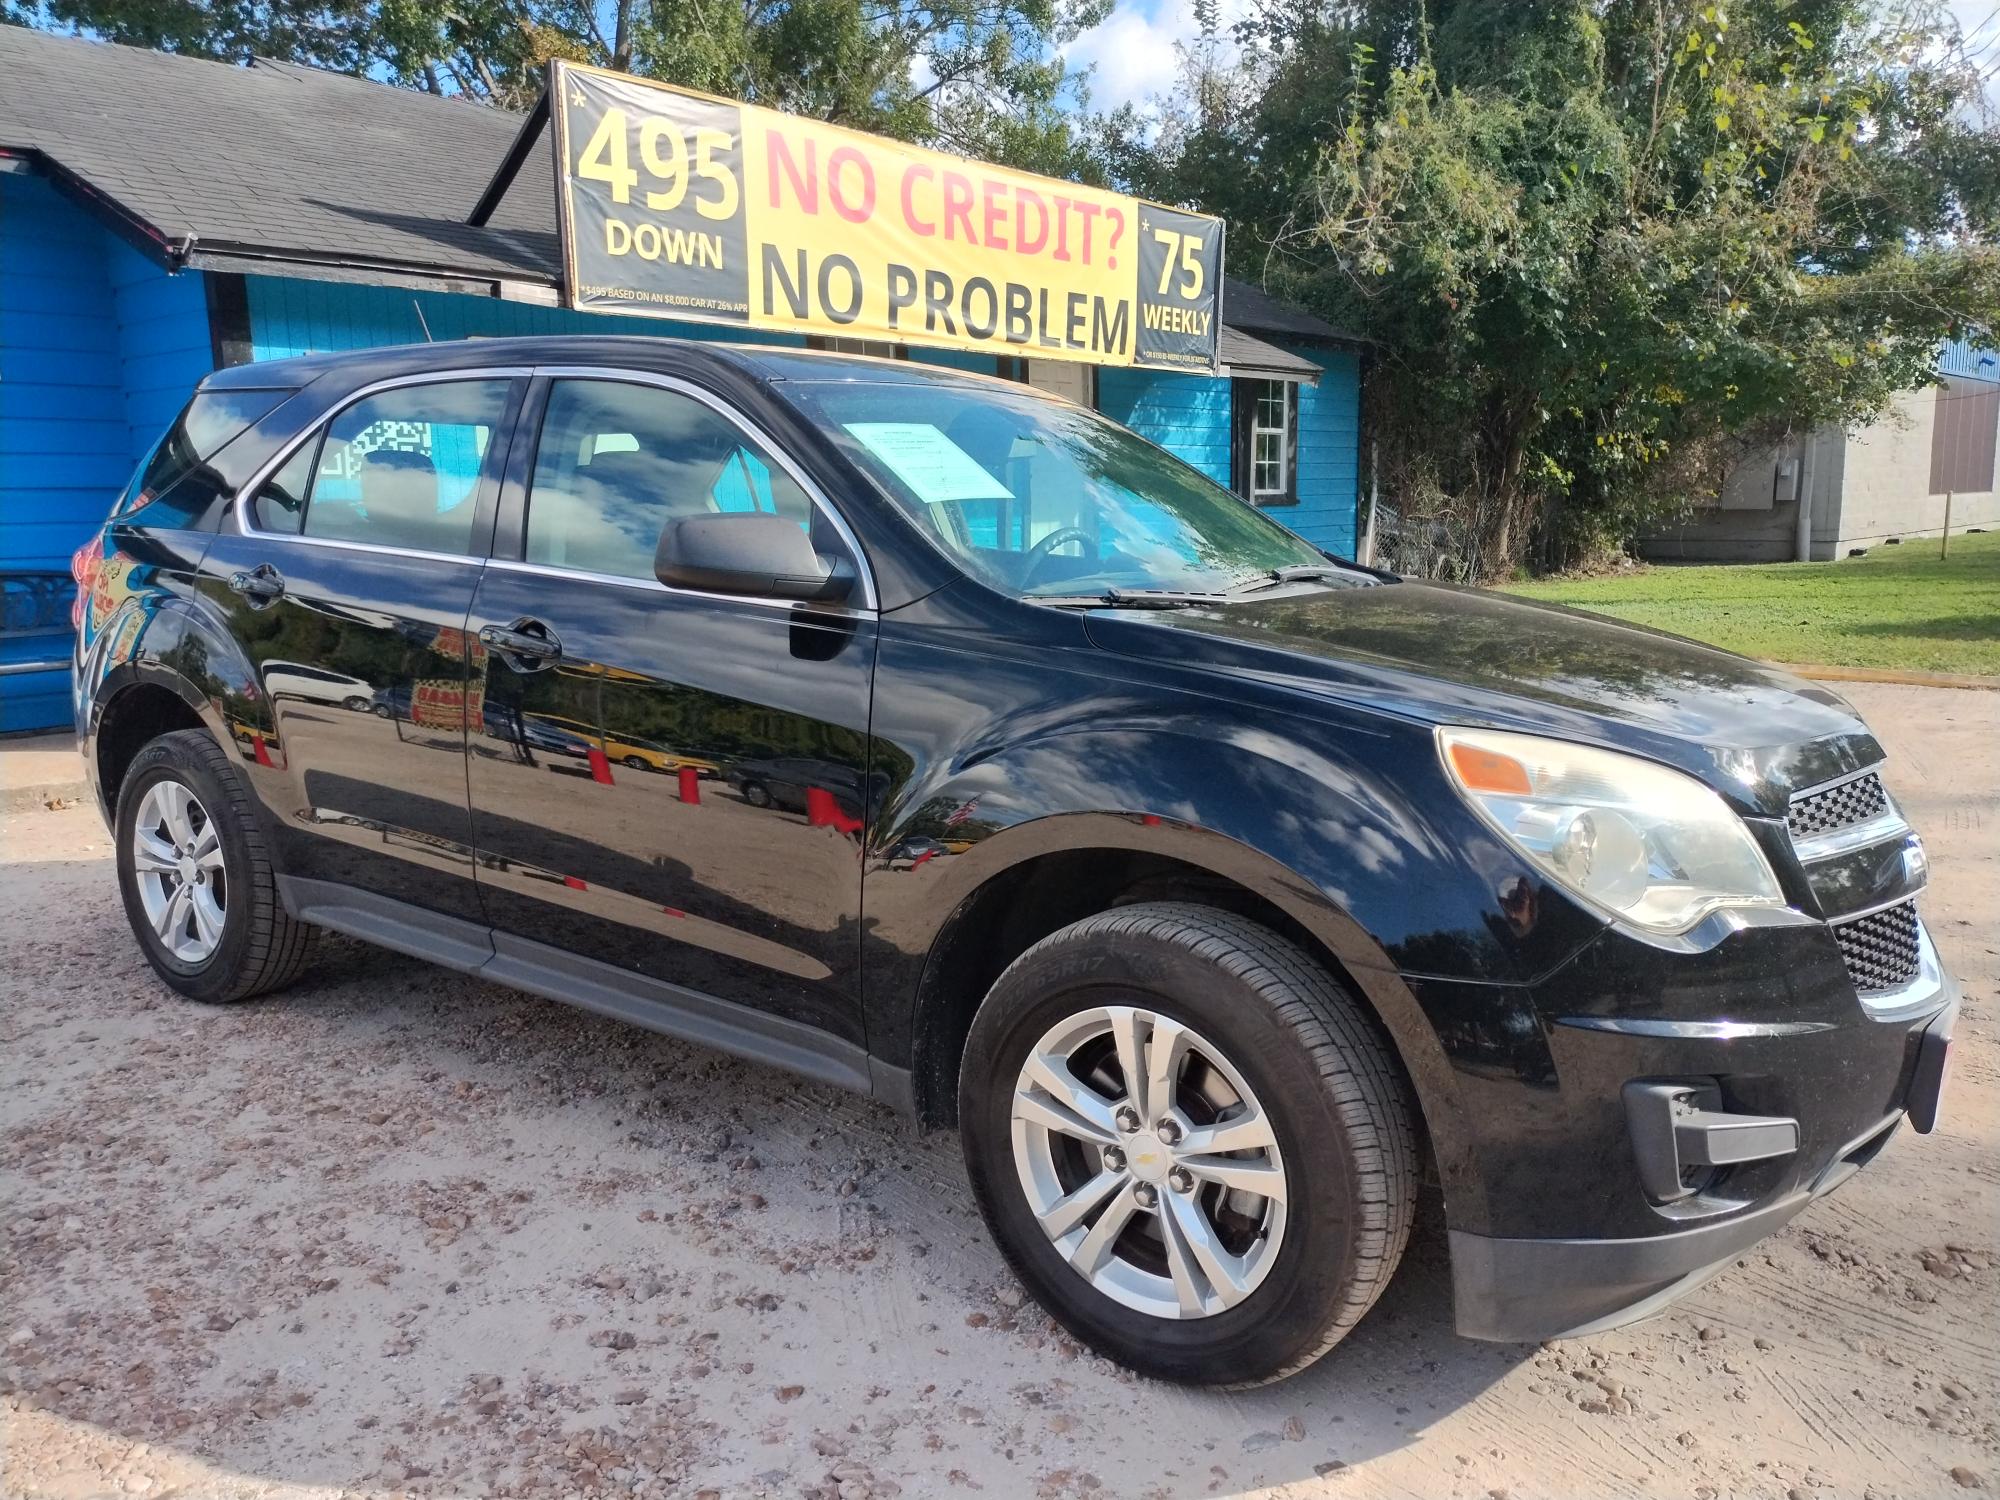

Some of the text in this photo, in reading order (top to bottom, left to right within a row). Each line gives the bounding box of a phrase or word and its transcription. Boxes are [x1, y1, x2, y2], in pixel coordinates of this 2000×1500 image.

[766, 128, 1125, 270] NO CREDIT?
[605, 219, 723, 270] DOWN
[608, 288, 635, 300] BASED
[636, 291, 650, 302] ON
[651, 293, 663, 303] AN
[664, 295, 689, 306] $8,000
[690, 297, 706, 308] CAR
[706, 299, 717, 309] AT
[717, 301, 732, 311] 26%
[733, 303, 748, 313] APR
[761, 243, 1129, 355] NO PROBLEM
[1143, 303, 1211, 337] WEEKLY
